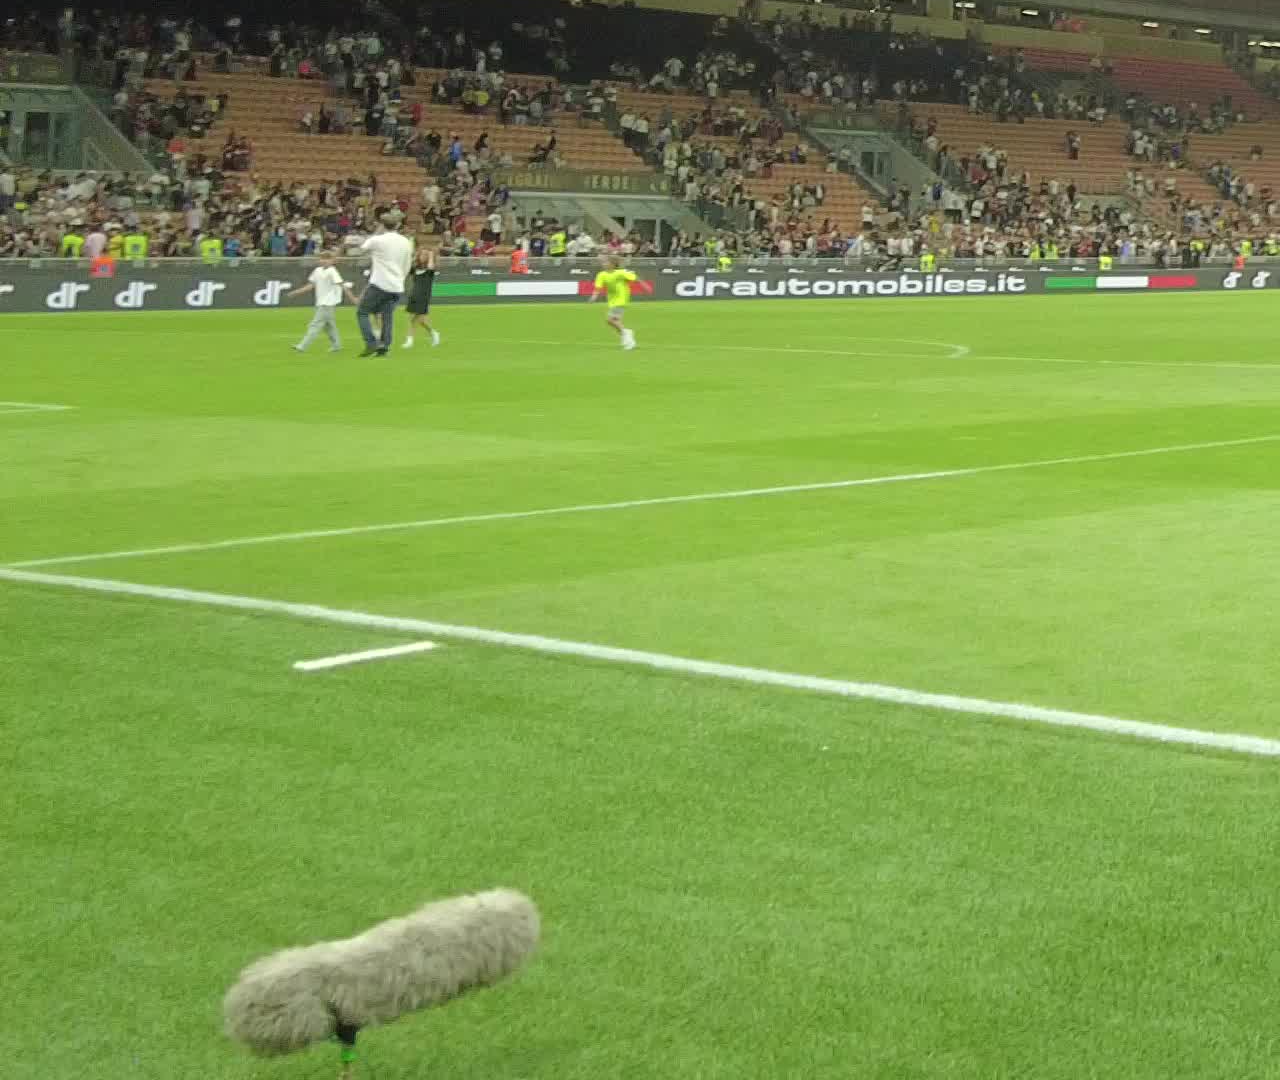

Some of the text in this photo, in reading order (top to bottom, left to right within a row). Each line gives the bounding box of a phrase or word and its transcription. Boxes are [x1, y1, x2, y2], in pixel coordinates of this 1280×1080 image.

[47, 282, 89, 308] dr
[115, 282, 156, 307] dr
[186, 282, 225, 306] dr
[254, 281, 291, 304] dr
[676, 274, 1026, 297] drautomobiles.it
